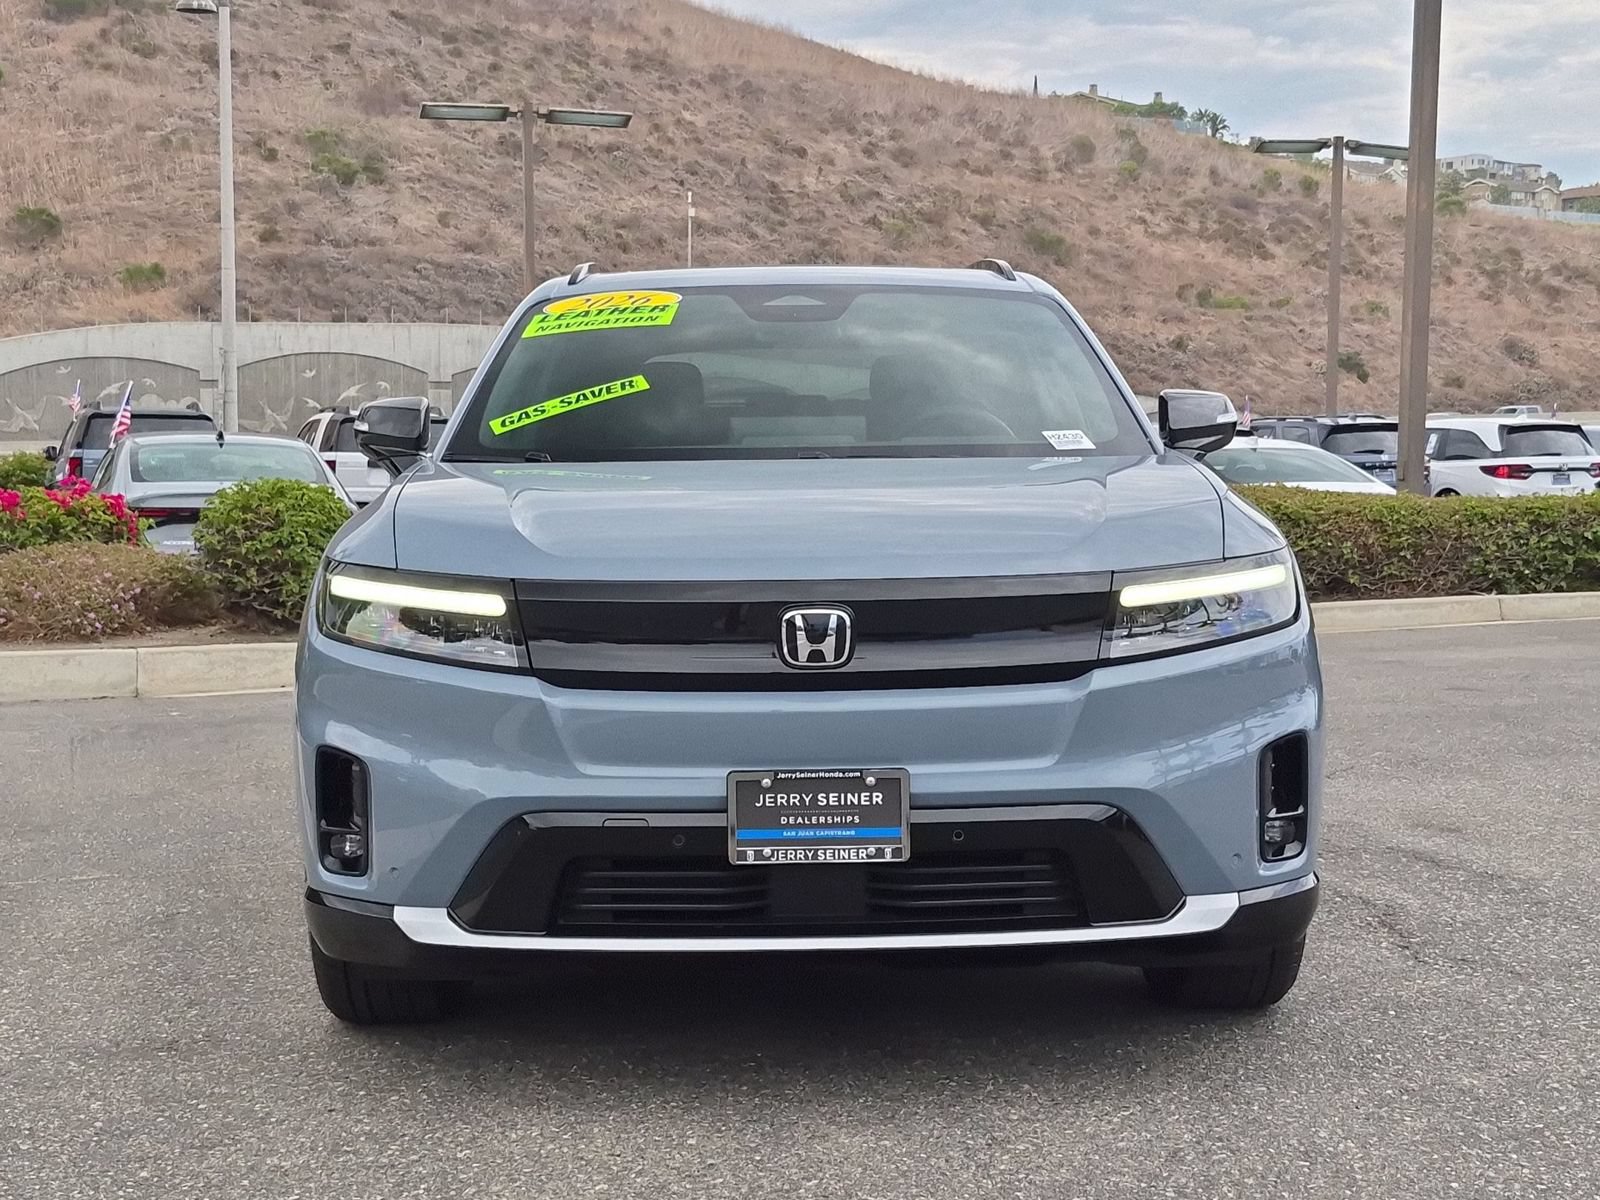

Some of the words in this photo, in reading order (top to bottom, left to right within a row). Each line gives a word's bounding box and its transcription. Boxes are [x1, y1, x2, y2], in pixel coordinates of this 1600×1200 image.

[567, 294, 652, 311] 2026
[538, 304, 670, 324] LEATHER
[535, 315, 659, 333] NAVIGATION
[499, 379, 637, 430] GAS-SAVER
[776, 770, 862, 780] JerrySeinerHonda.com
[754, 793, 814, 808] JERRY
[816, 791, 884, 806] SEINER
[780, 815, 860, 825] DEALERSHIPS
[770, 850, 815, 861] JERRY
[817, 848, 867, 860] SEINER
